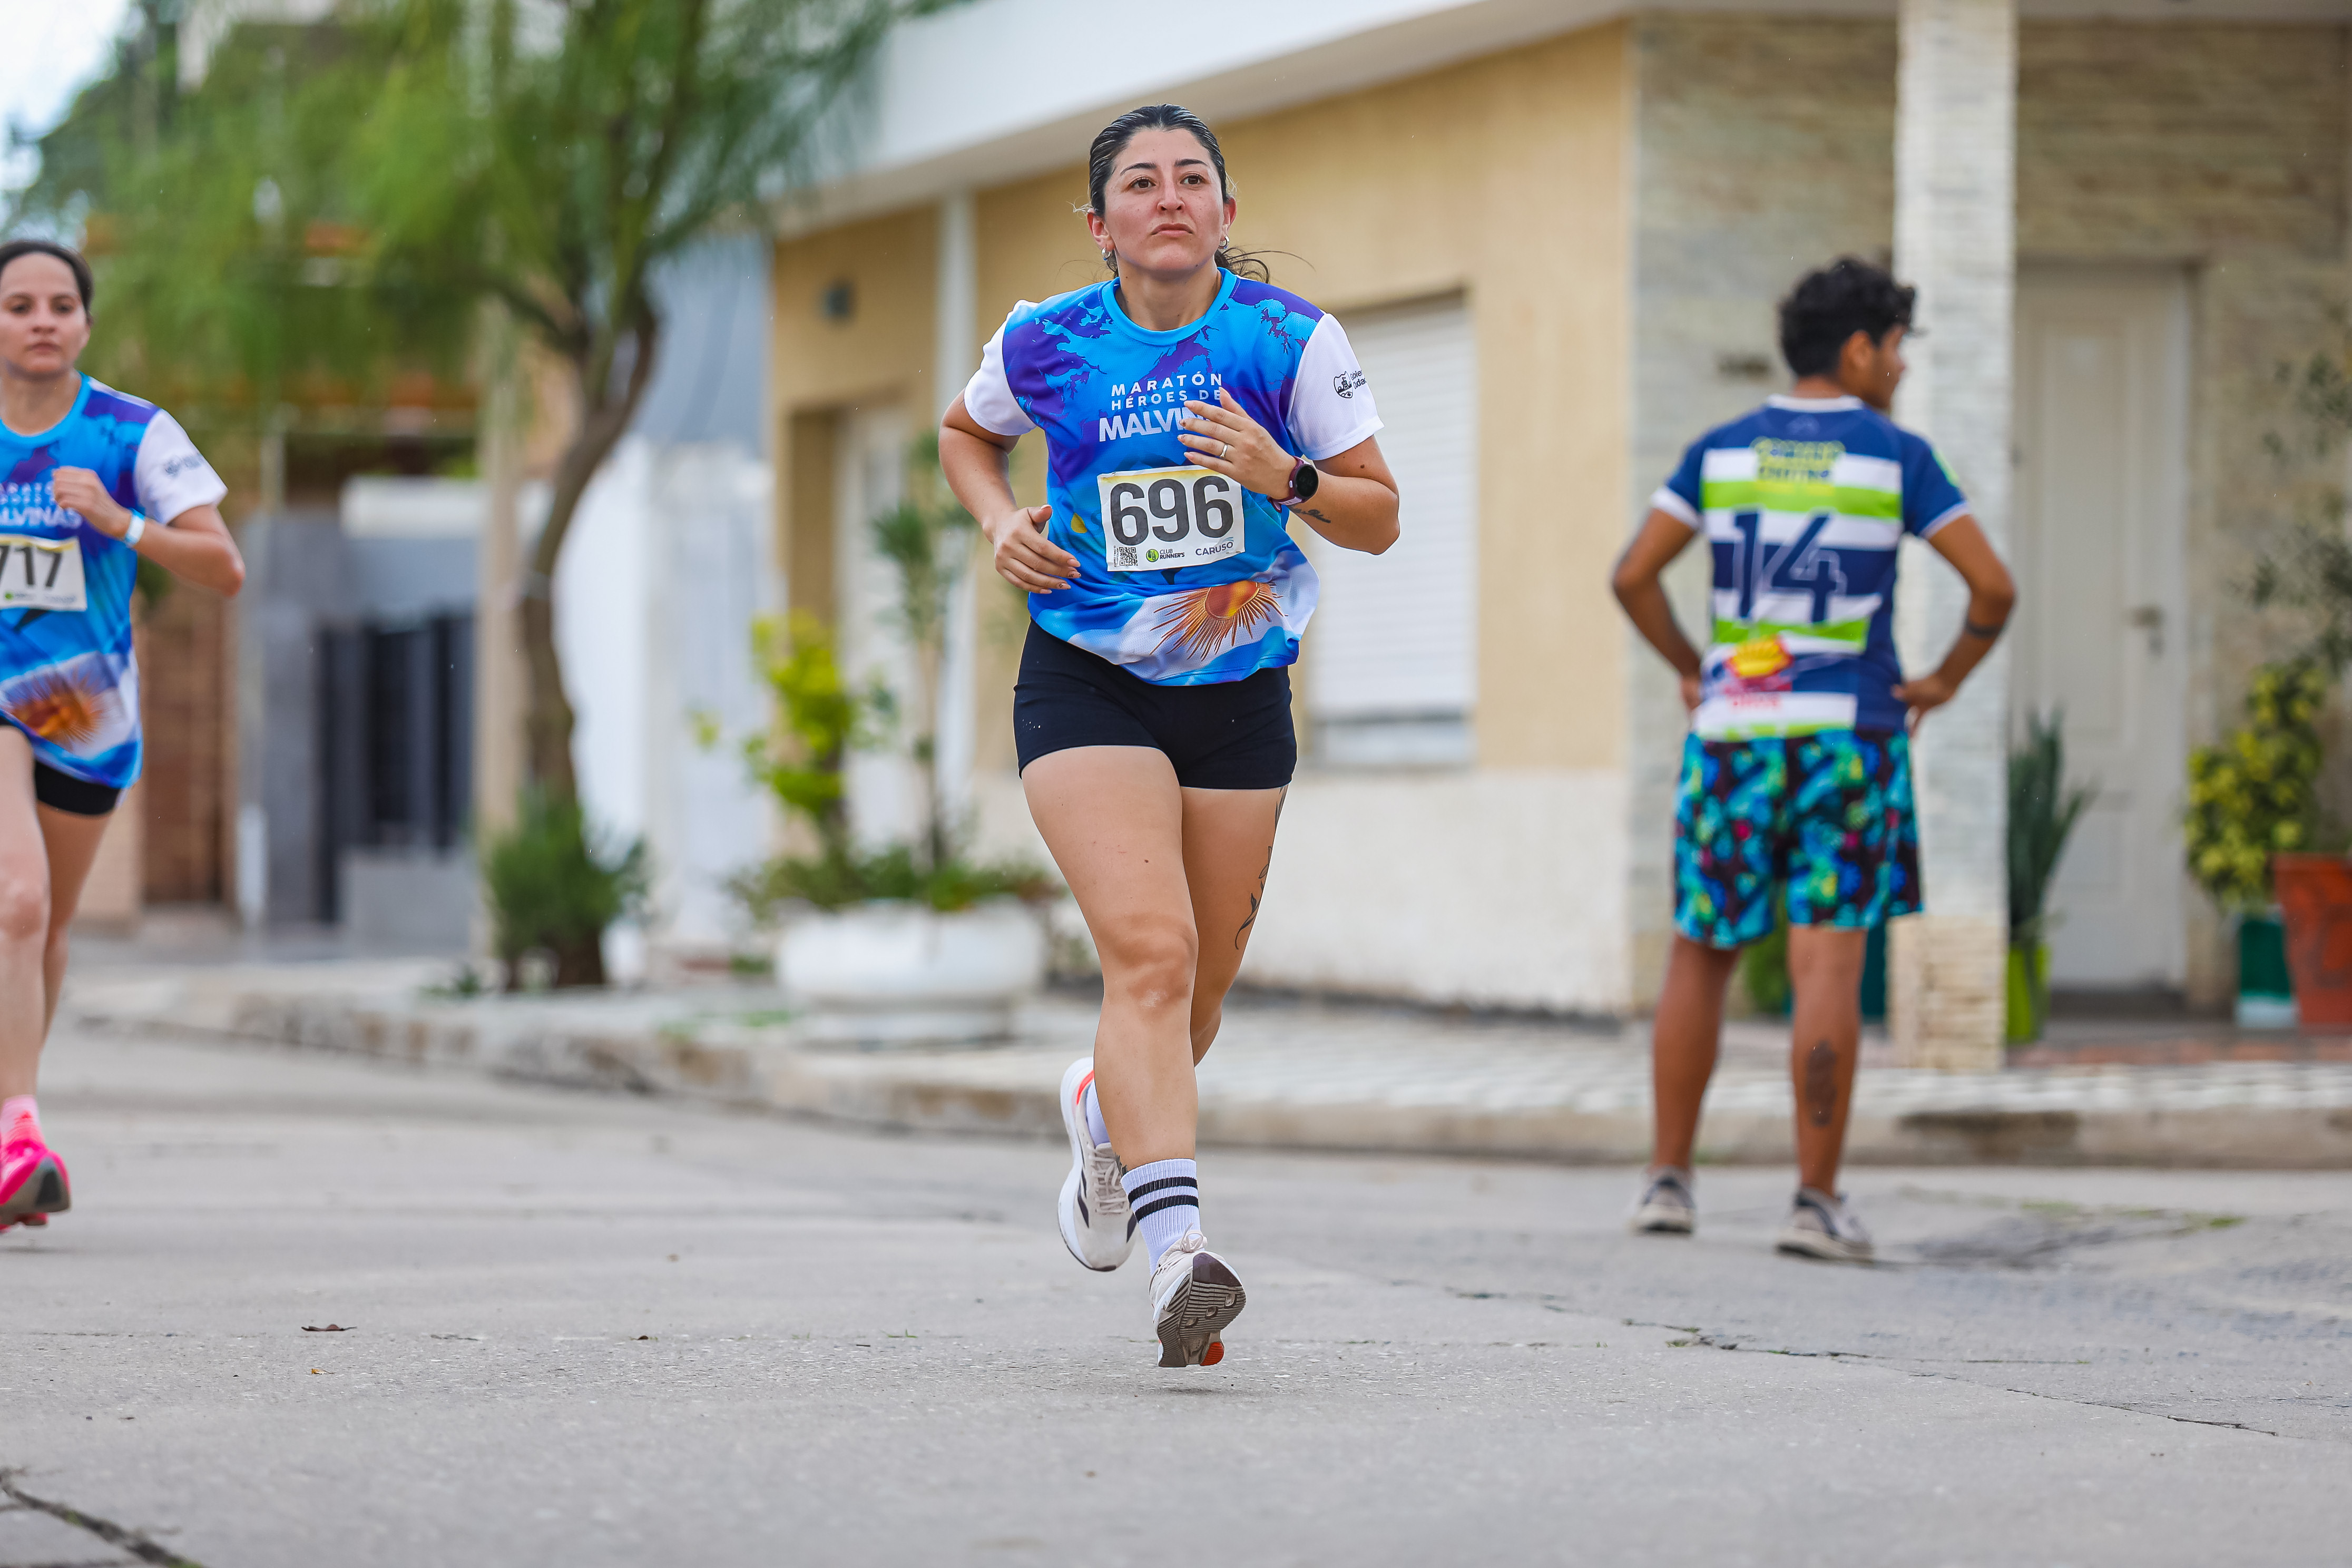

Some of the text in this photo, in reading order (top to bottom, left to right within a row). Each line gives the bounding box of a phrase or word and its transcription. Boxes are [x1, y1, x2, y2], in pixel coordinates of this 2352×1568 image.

[1111, 371, 1221, 396] MARATÓN
[1112, 389, 1221, 411] HÉROES DE
[1110, 476, 1233, 546] 696
[1195, 541, 1233, 556] CARUSO
[1733, 510, 1839, 623] 14
